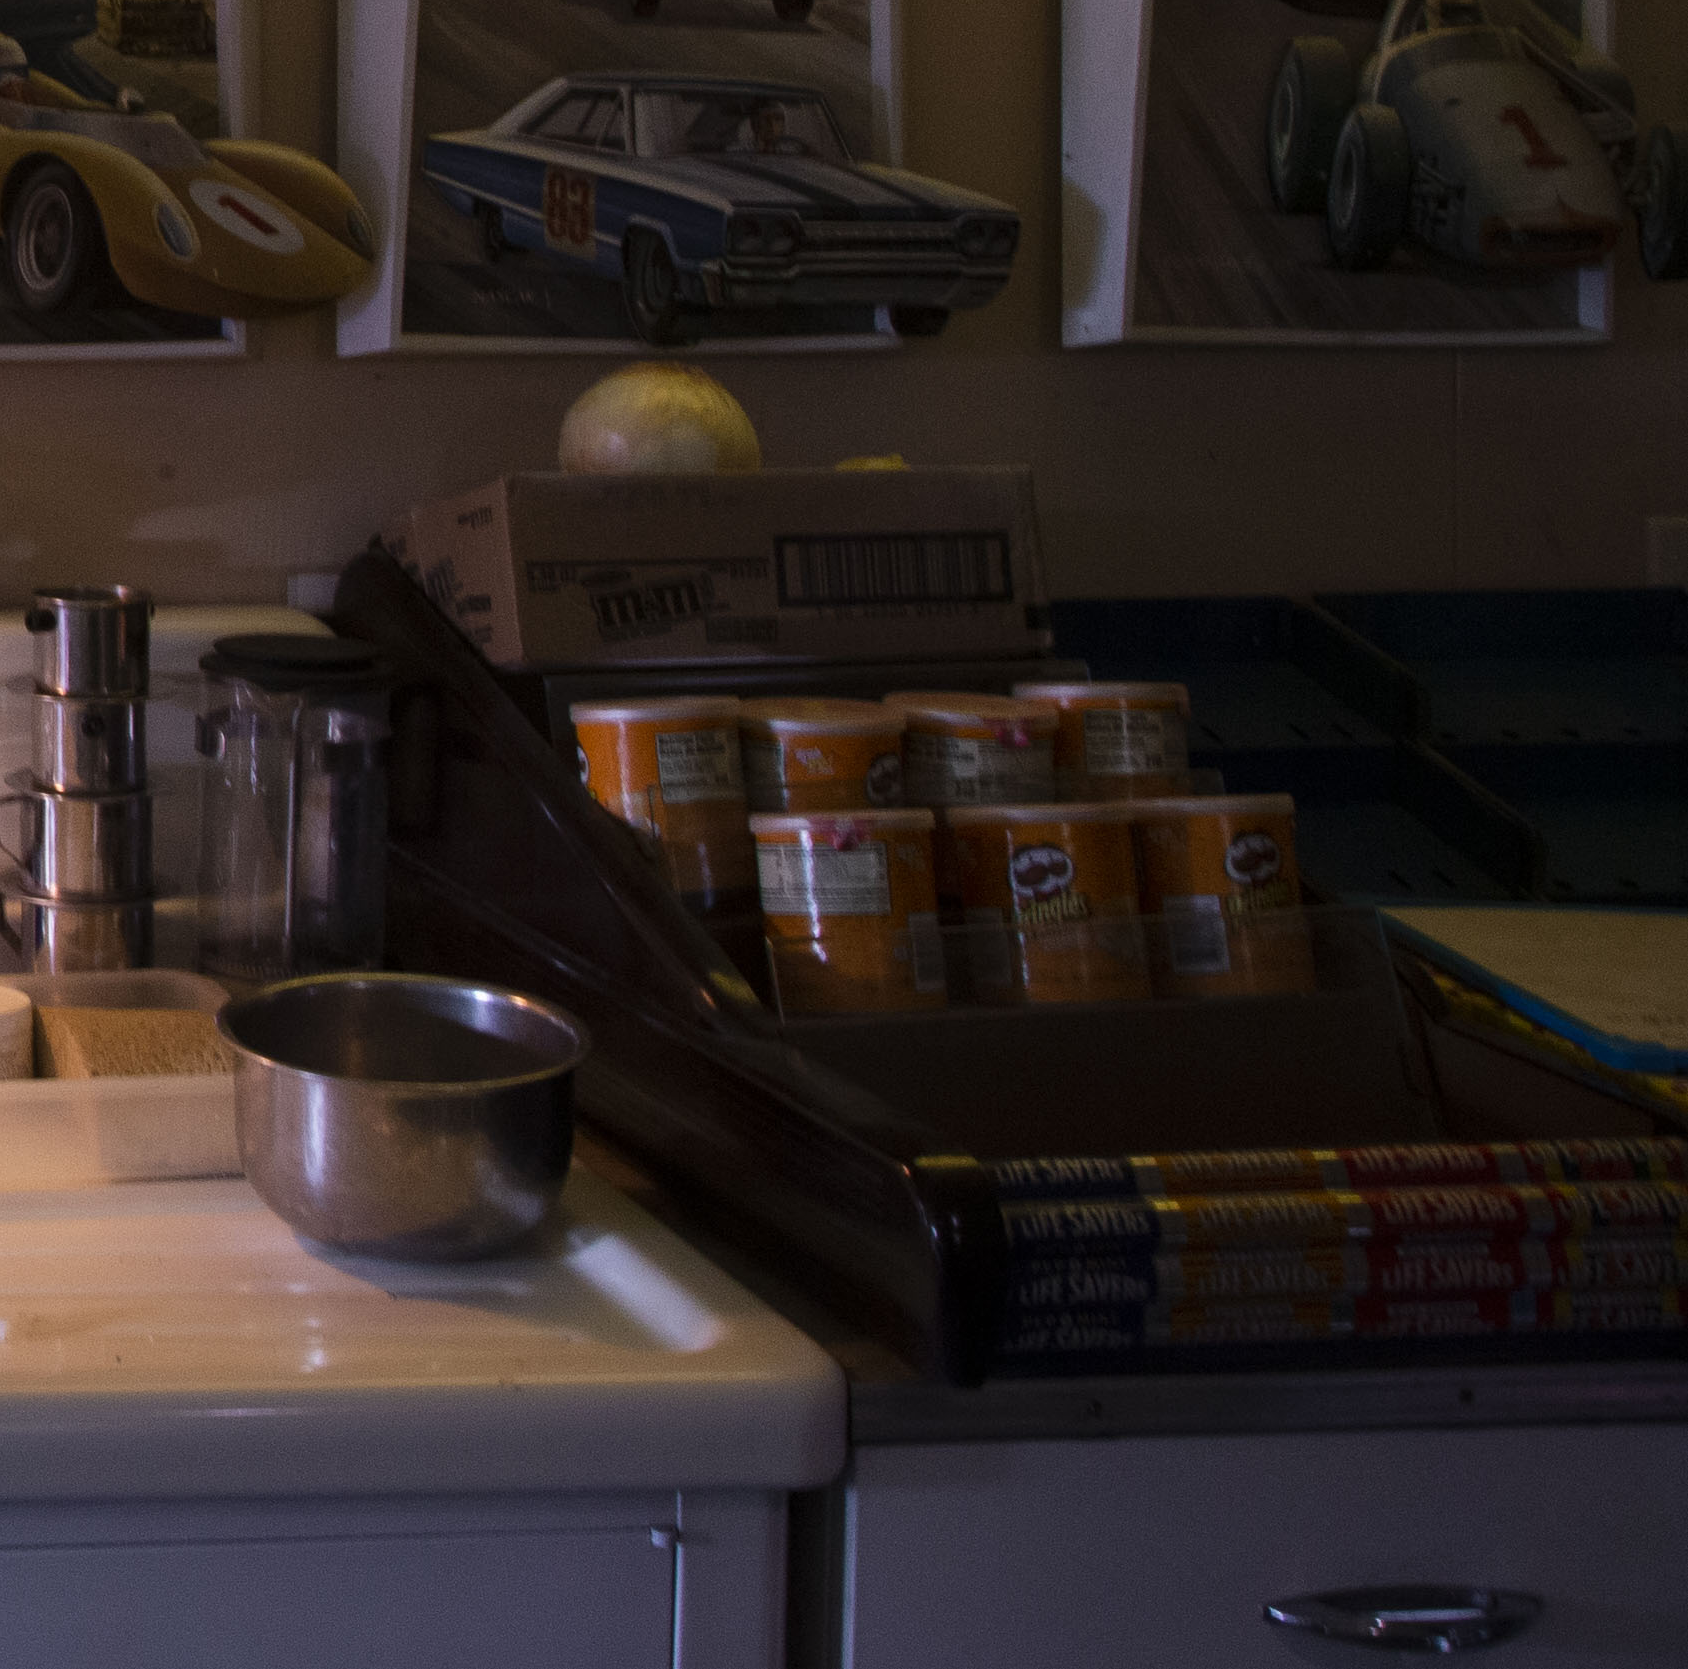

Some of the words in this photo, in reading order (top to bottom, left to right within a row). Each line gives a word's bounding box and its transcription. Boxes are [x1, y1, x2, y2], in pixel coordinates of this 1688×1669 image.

[1501, 107, 1567, 170] 1
[1020, 1209, 1067, 1238] LIFE
[1070, 1206, 1151, 1235] SAVERS
[1380, 1188, 1424, 1225] LIFE
[1425, 1185, 1519, 1223] SAVERS
[1020, 1276, 1063, 1306] LIFE
[1068, 1272, 1149, 1301] SAVERS
[1381, 1259, 1426, 1289] LIFE
[1429, 1256, 1516, 1288] SAVERS
